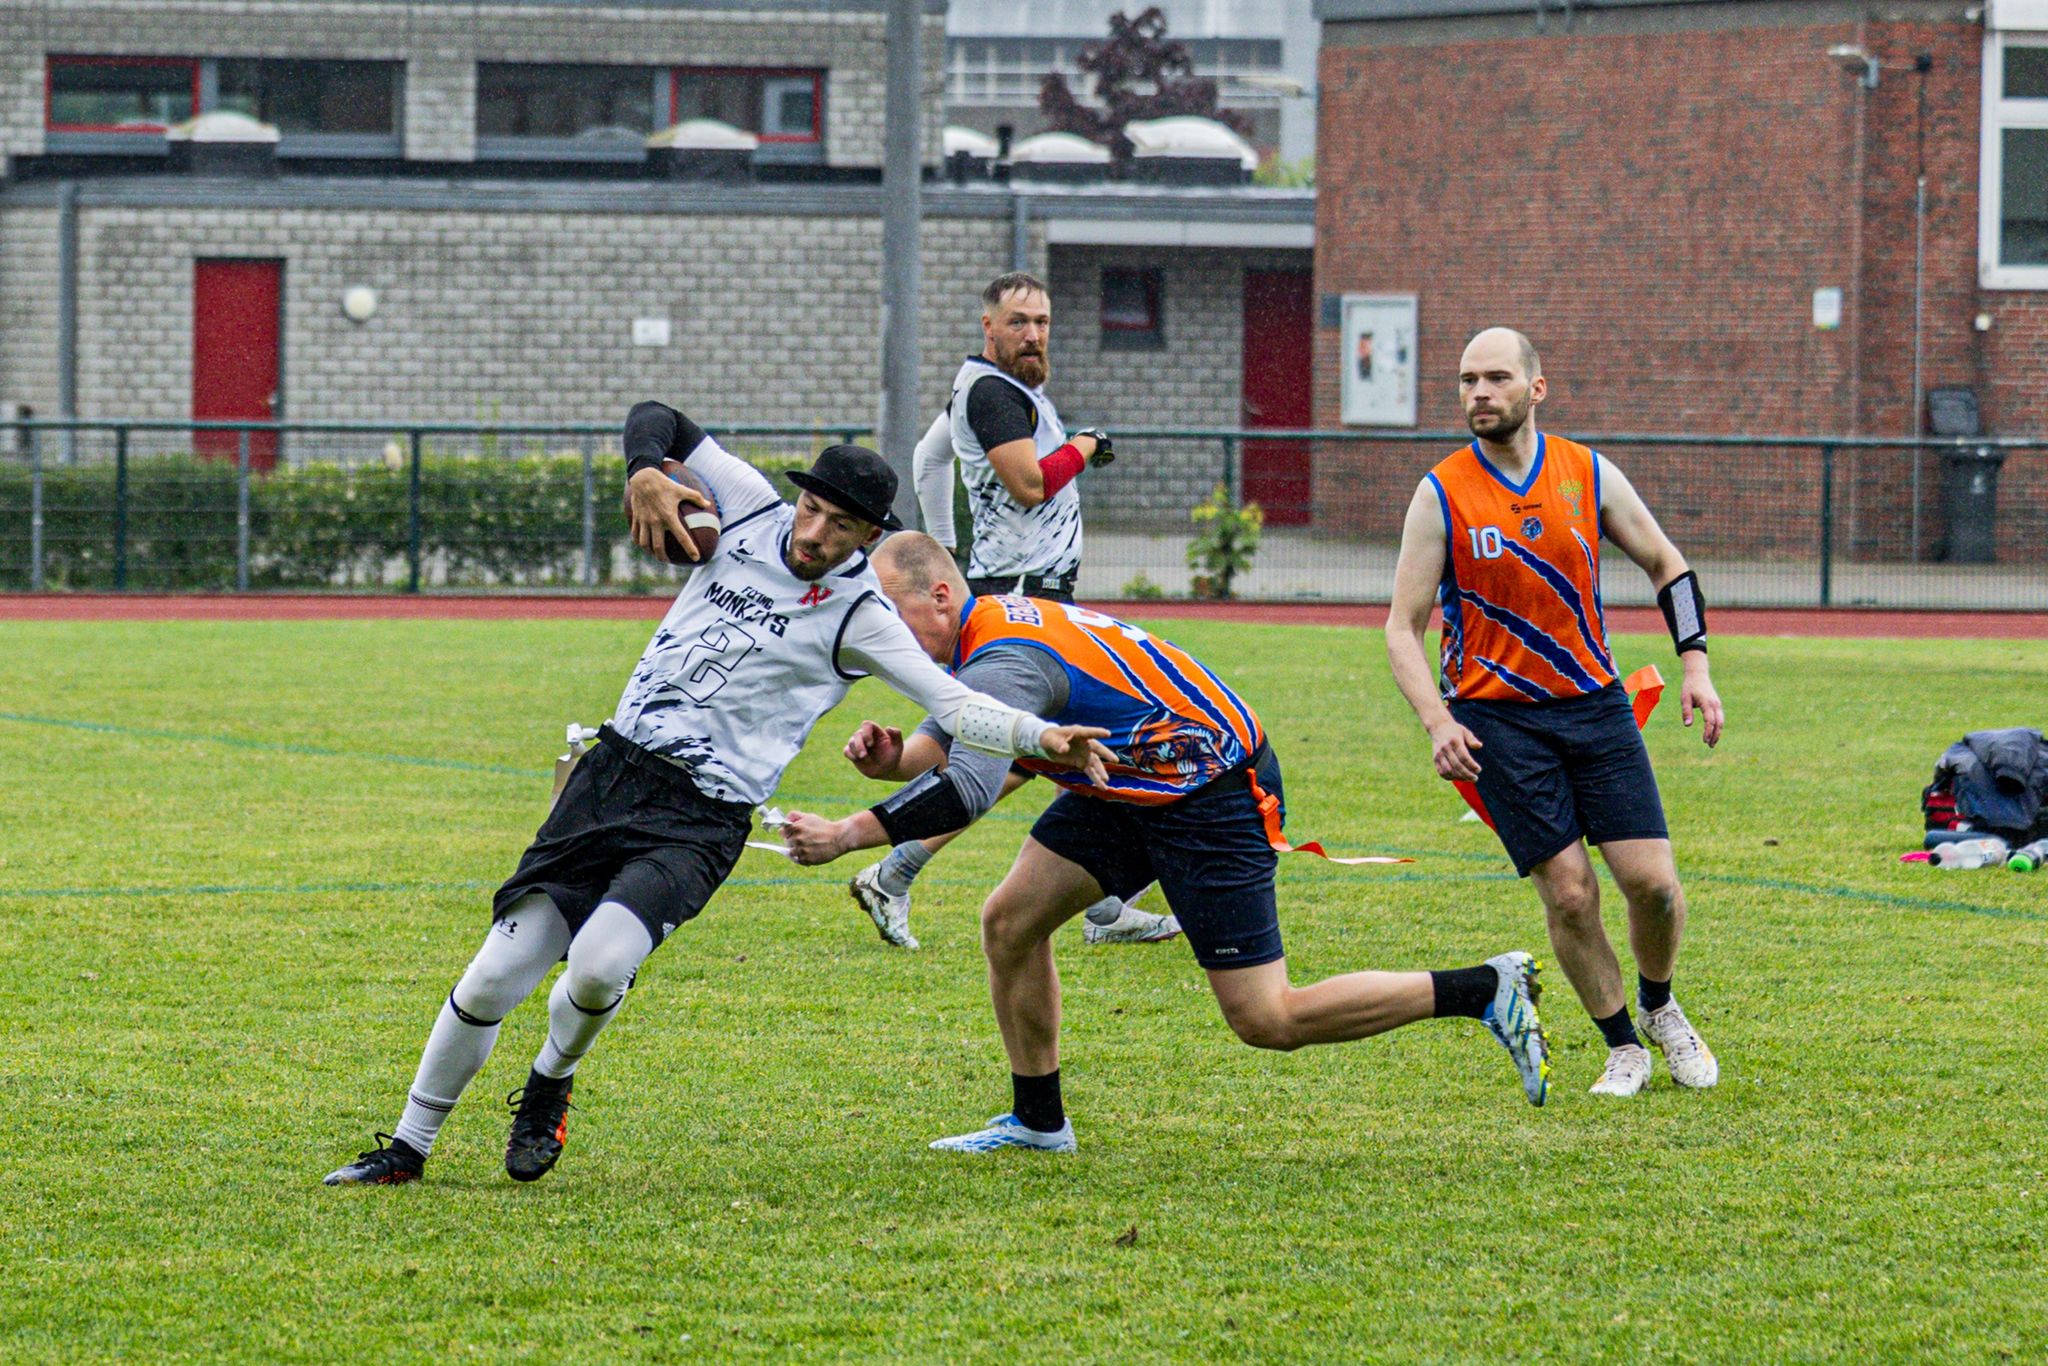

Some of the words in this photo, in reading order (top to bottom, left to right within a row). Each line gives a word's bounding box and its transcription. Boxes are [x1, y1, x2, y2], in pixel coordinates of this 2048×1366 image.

[1467, 525, 1504, 560] 10
[741, 585, 774, 610] FLYING
[664, 617, 756, 703] 2
